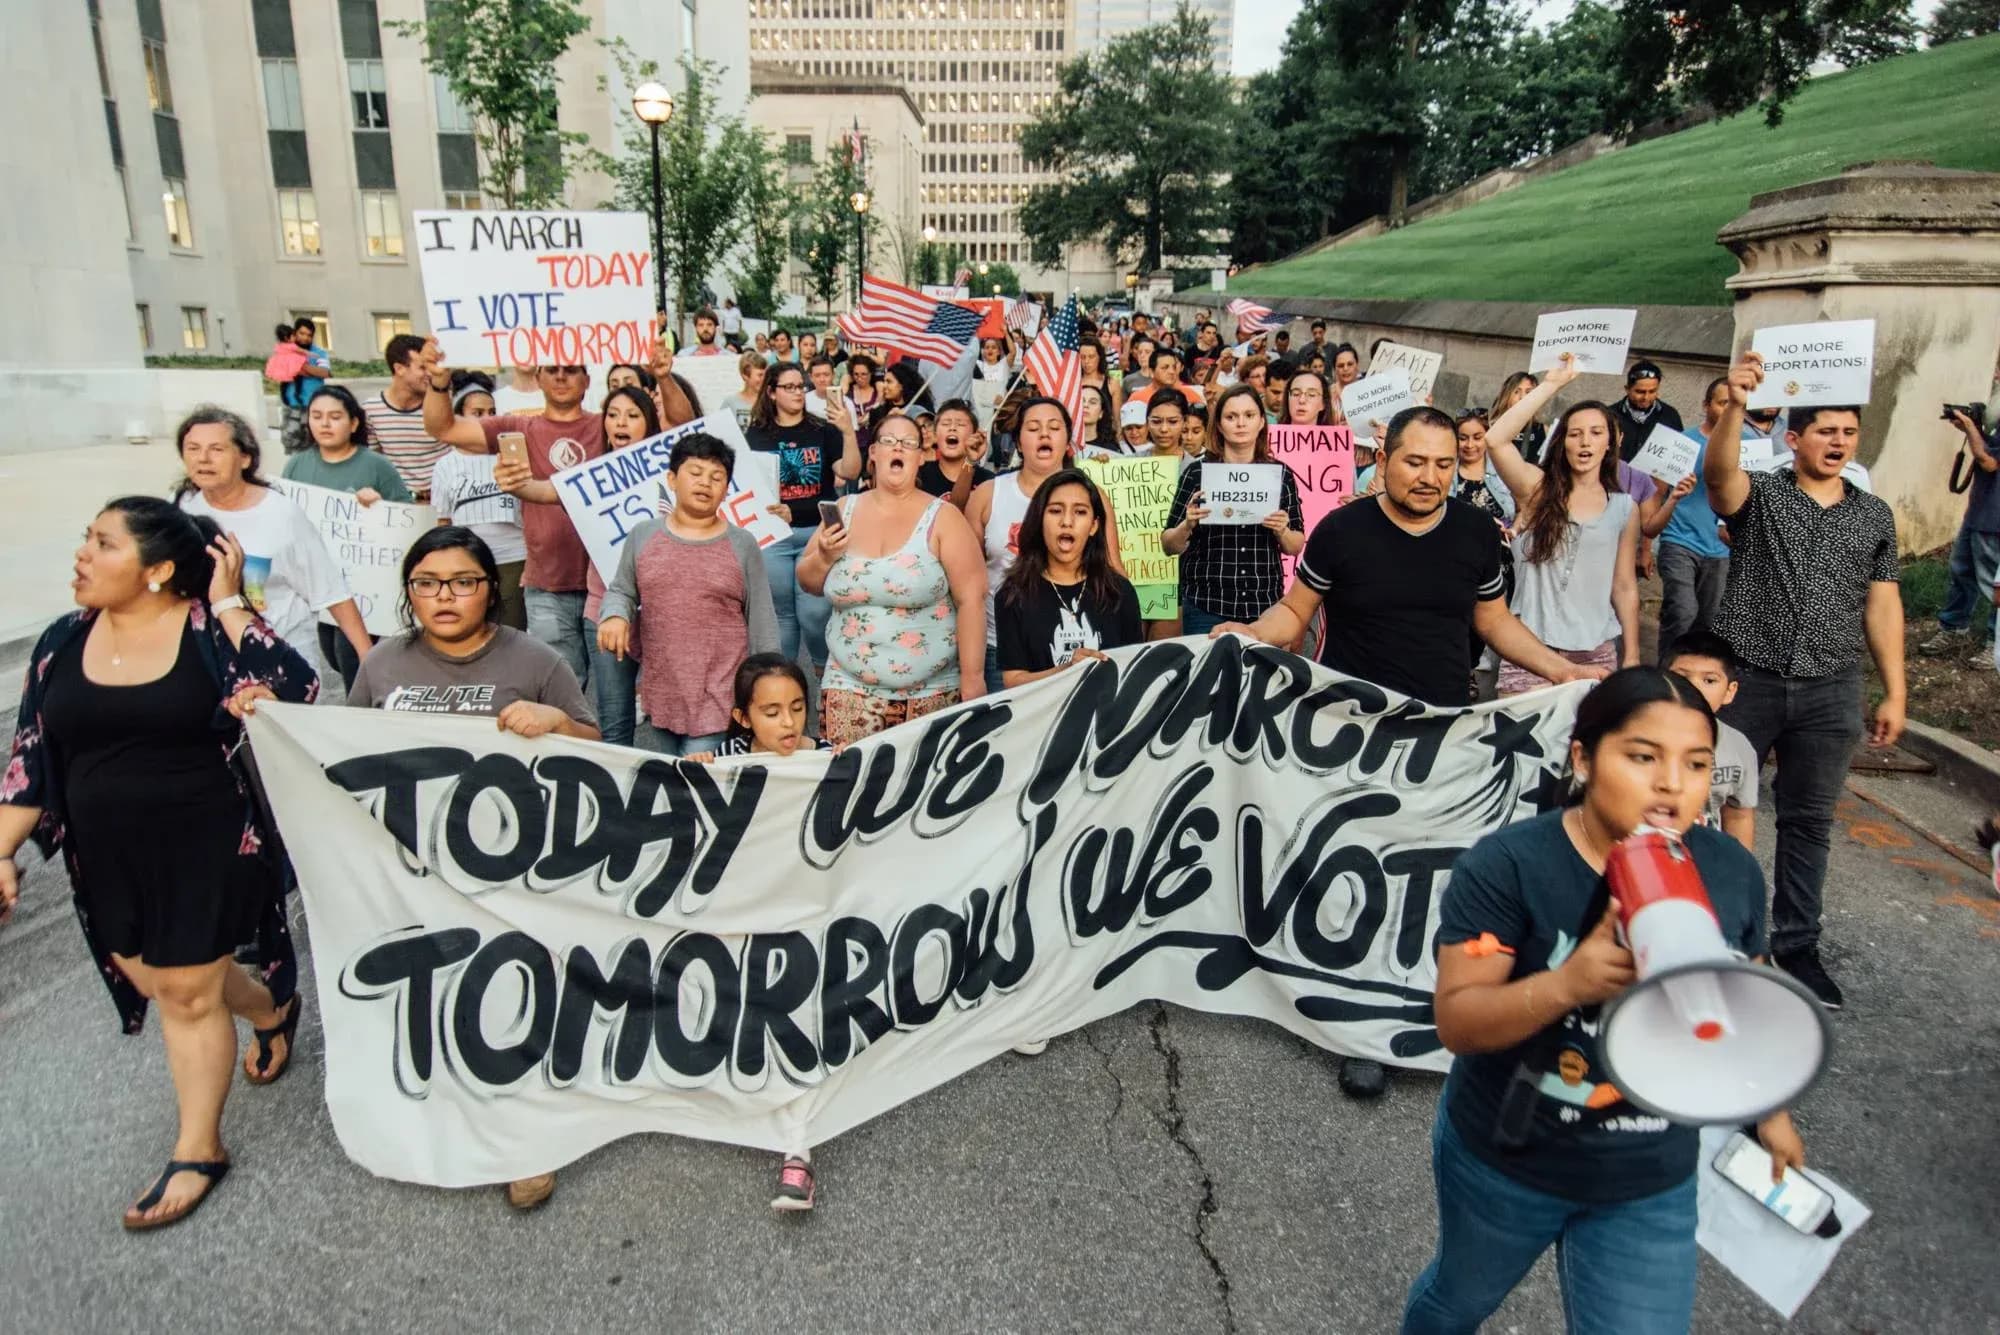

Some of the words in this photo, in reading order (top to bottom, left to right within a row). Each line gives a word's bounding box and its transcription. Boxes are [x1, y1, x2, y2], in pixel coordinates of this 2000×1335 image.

[420, 218, 455, 251] I
[470, 216, 583, 250] MARCH
[537, 252, 649, 288] TODAY
[433, 299, 467, 332] I
[478, 292, 566, 329] VOTE
[1558, 324, 1574, 333] NO
[1576, 323, 1610, 331] MORE
[481, 320, 657, 368] TOMORROW
[1538, 335, 1626, 347] DEPORTATIONS!
[1778, 344, 1798, 354] NO
[1802, 341, 1844, 353] MORE
[1347, 389, 1408, 417] DEPORTATIONS!
[1358, 392, 1370, 401] NO
[1371, 384, 1393, 397] MORE
[1268, 430, 1350, 453] HUMAN
[1647, 442, 1667, 459] WE
[1102, 460, 1167, 486] LONGER
[1229, 472, 1250, 482] NO
[499, 496, 514, 509] 39
[1125, 483, 1177, 509] THINGS
[1211, 491, 1268, 502] HB2315!
[384, 505, 416, 529] IS
[1117, 509, 1168, 533] HANGE
[1140, 557, 1177, 581] ACCEPT
[401, 684, 496, 703] ELITE
[394, 702, 450, 712] Martial
[456, 702, 493, 711] Arts
[322, 745, 768, 918] TODAY
[801, 698, 1012, 870] WE
[1017, 634, 1472, 808] MARCH
[338, 800, 1058, 1100] TOMORROW
[1062, 761, 1220, 946] WE
[1236, 783, 1468, 972] VOT
